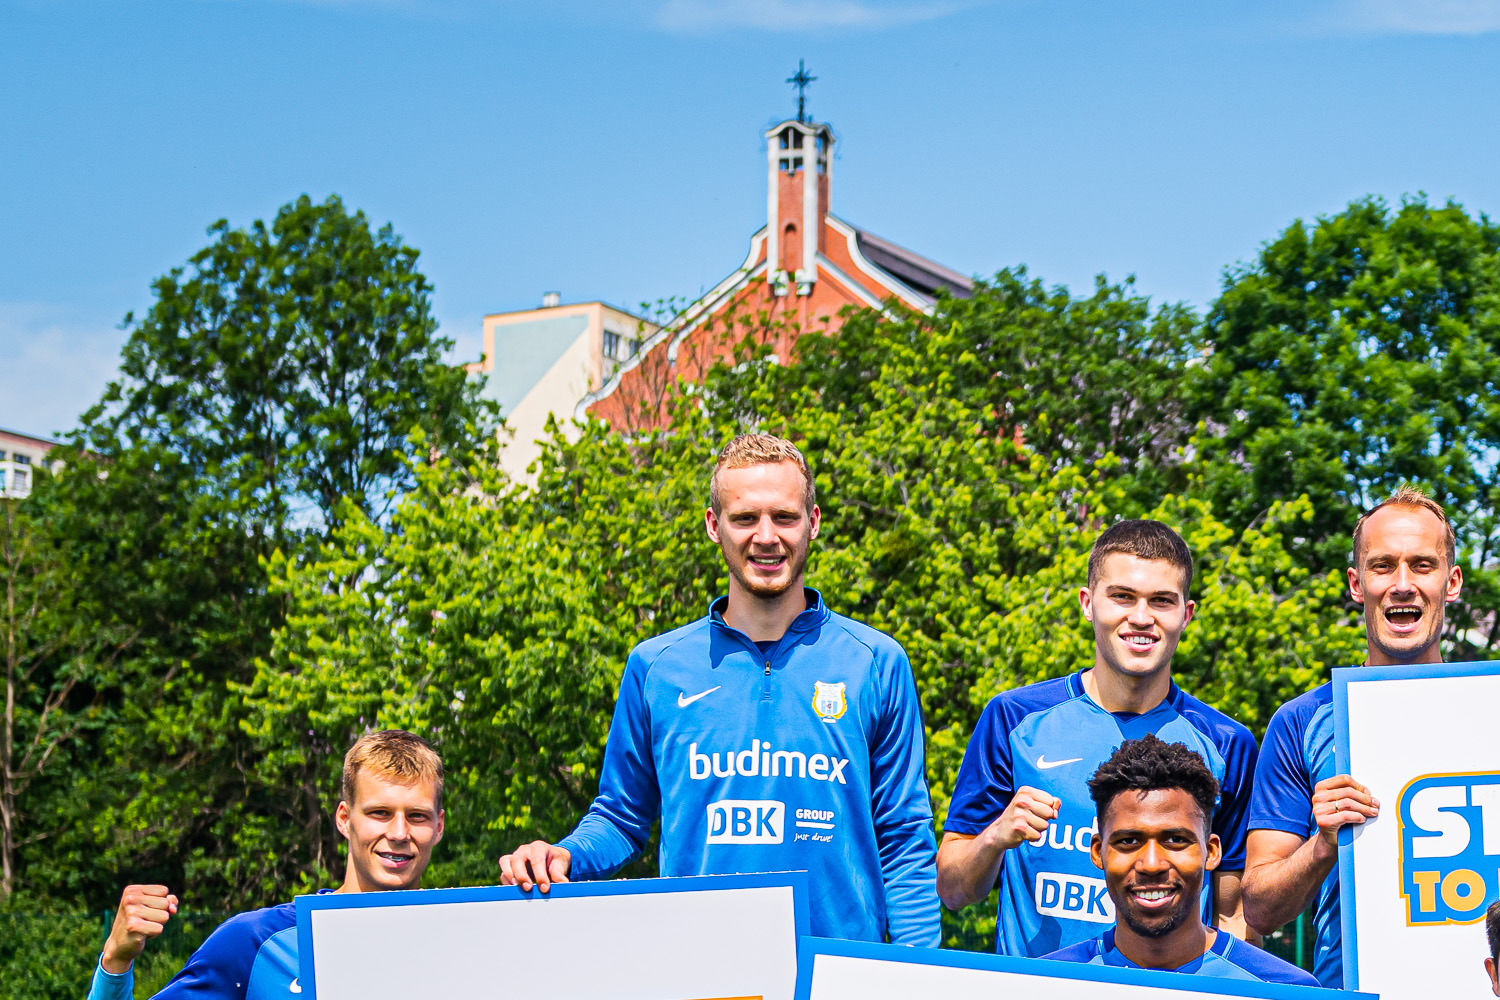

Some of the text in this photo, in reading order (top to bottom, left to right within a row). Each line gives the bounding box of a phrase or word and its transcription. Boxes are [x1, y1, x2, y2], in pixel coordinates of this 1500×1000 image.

[689, 739, 850, 784] budimex
[710, 807, 835, 837] DBK GROUP
[1041, 879, 1108, 916] DBK
[1413, 868, 1486, 912] TO
